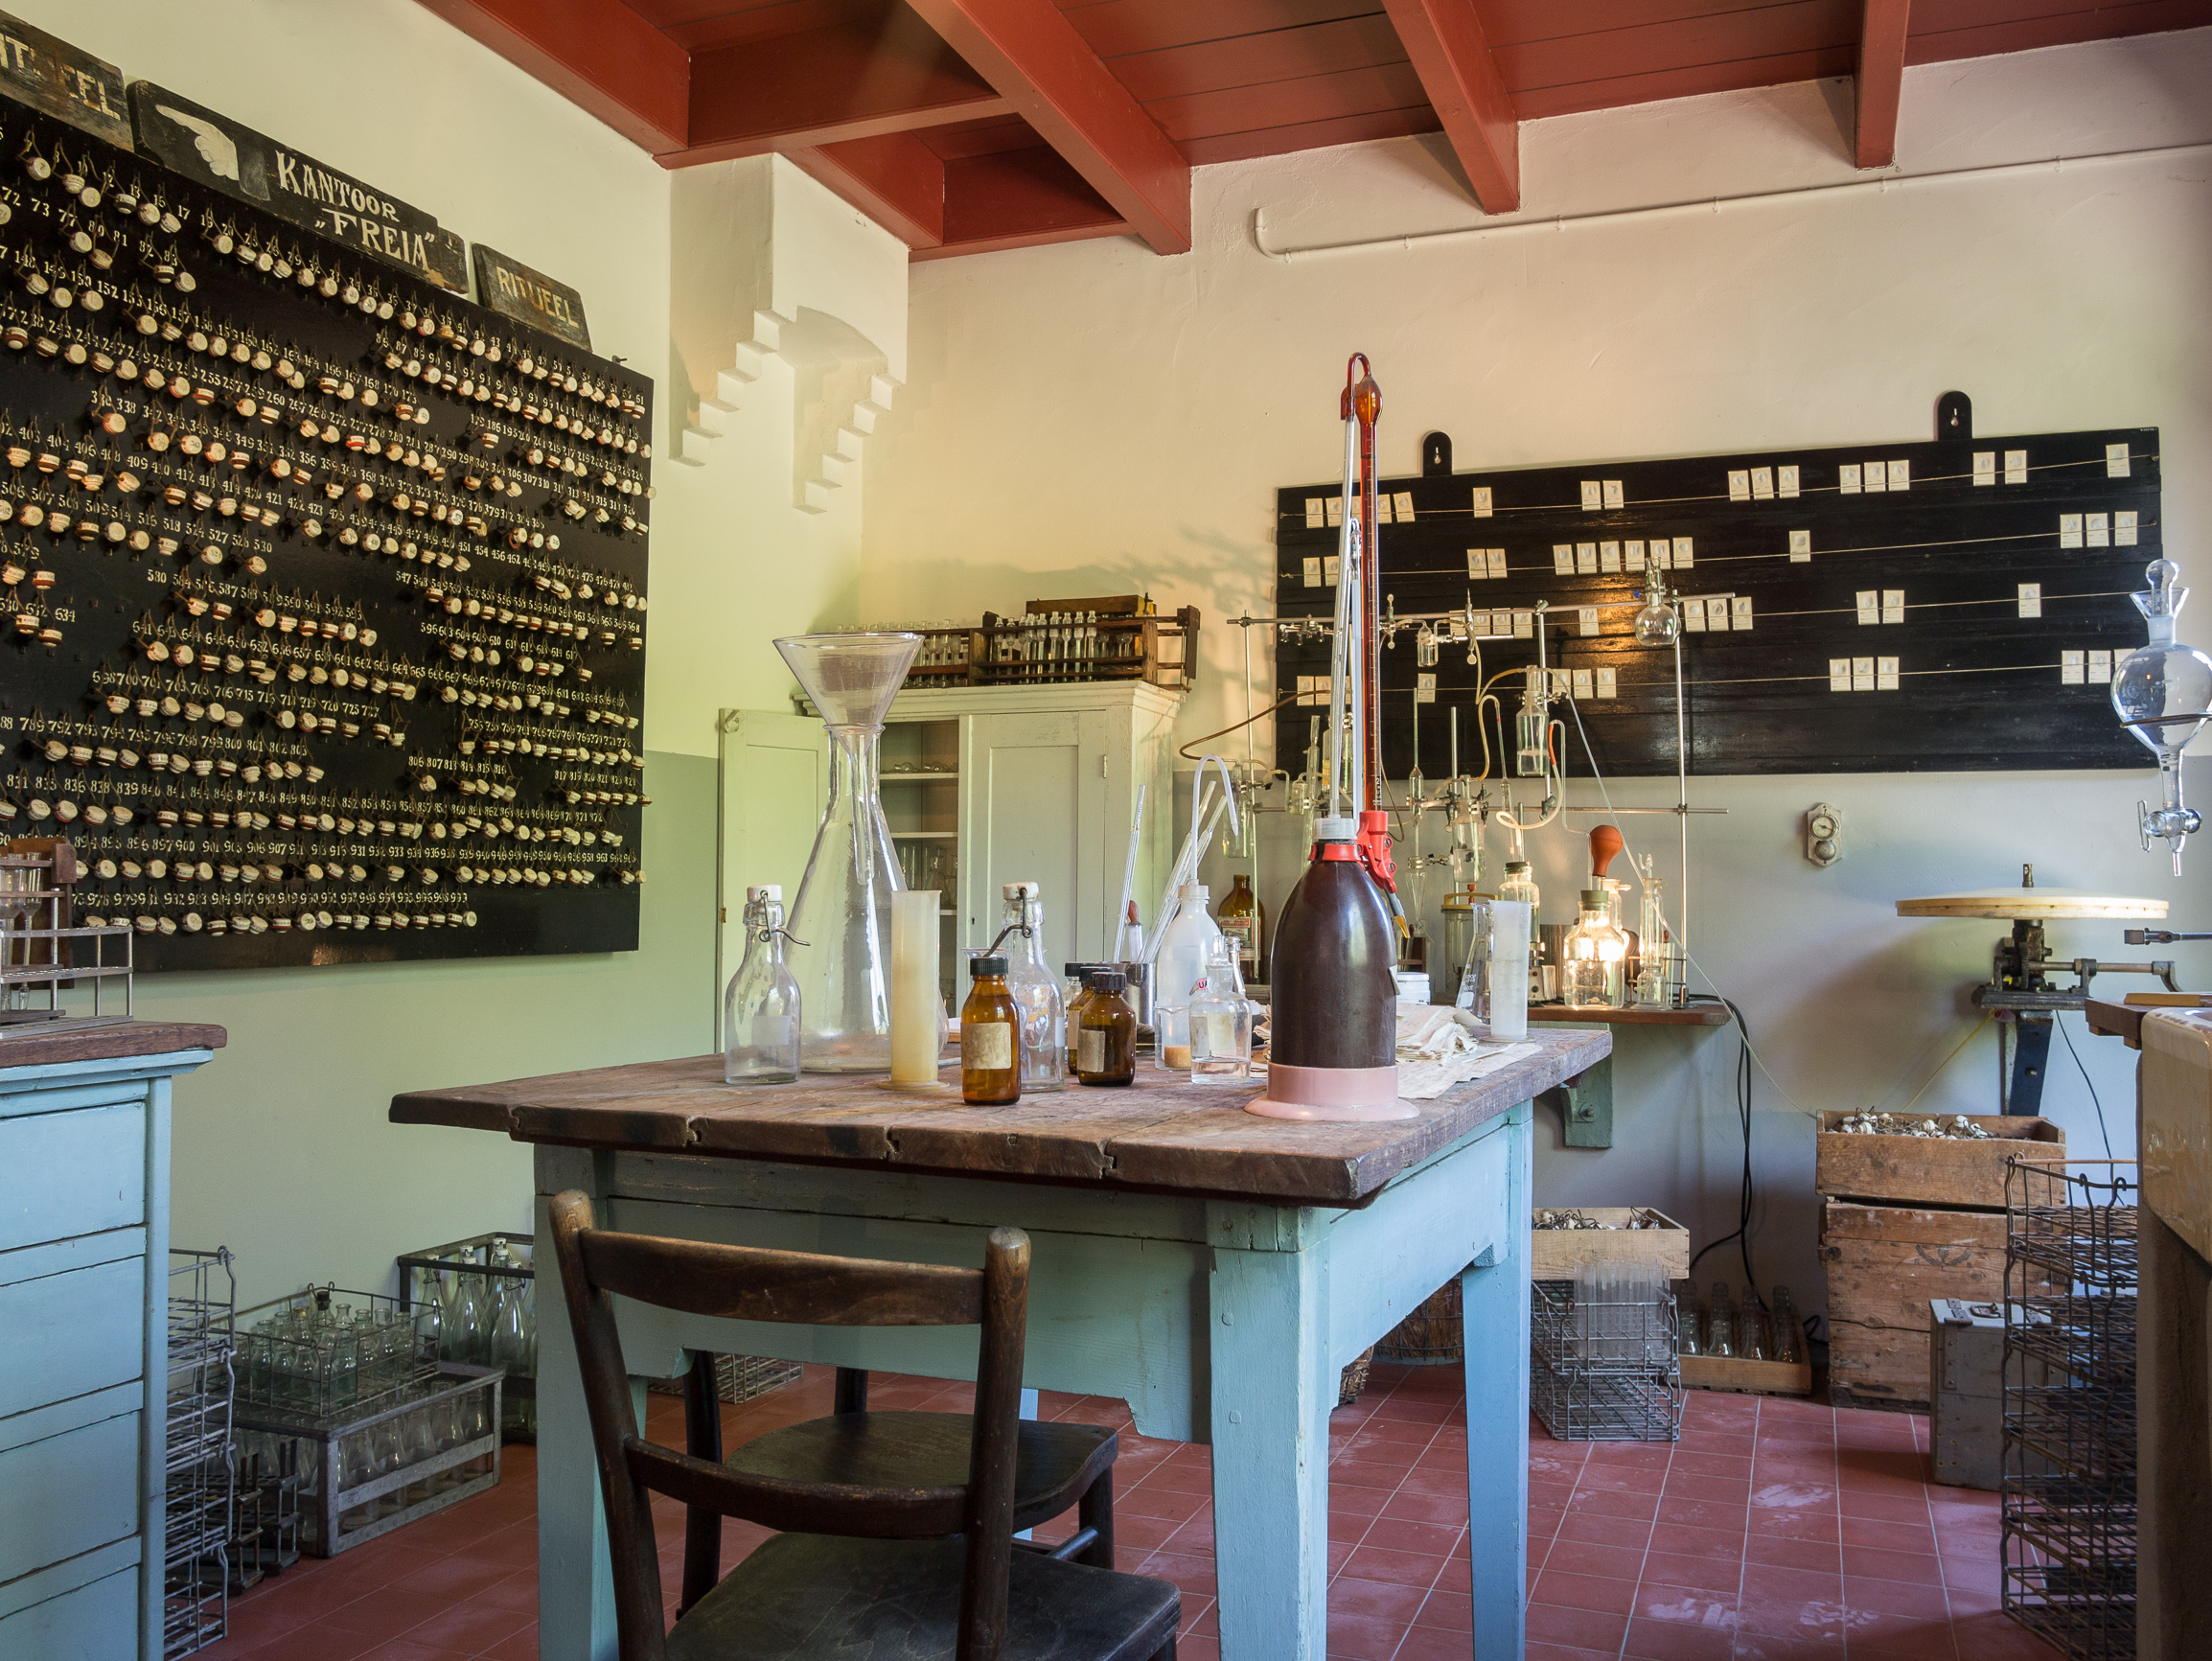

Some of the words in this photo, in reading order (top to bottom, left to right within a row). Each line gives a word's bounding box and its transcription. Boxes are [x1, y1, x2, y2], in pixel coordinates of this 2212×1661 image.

[178, 205, 192, 220] 17
[275, 150, 401, 222] KANTOOR
[2, 186, 22, 207] 72
[32, 198, 50, 218] 73
[88, 220, 105, 237] 80
[114, 231, 127, 247] 81
[140, 241, 154, 258] 82
[396, 341, 407, 355] 87
[496, 265, 579, 329] RITUEEL
[98, 281, 119, 300] 152
[364, 377, 380, 391] 168
[488, 420, 501, 432] 186
[117, 399, 137, 415] 338
[235, 434, 255, 450] 349
[299, 452, 317, 467] 356
[360, 470, 378, 483] 368
[200, 370, 221, 386] 255
[266, 392, 286, 406] 260
[369, 425, 386, 439] 278
[508, 468, 522, 481] 306
[523, 473, 538, 486] 307
[127, 456, 149, 471] 409
[458, 542, 472, 553] 451
[474, 545, 490, 558] 454
[492, 549, 507, 562] 456
[507, 553, 521, 565] 462
[164, 519, 182, 533] 518
[209, 529, 229, 544] 527
[254, 540, 273, 553] 530
[396, 571, 412, 585] 547
[56, 608, 77, 623] 634
[148, 569, 168, 584] 580
[219, 584, 240, 598] 587
[421, 622, 438, 634] 596
[489, 635, 502, 647] 610
[237, 688, 255, 703] 715
[20, 718, 45, 732] 789
[225, 738, 242, 750] 800
[427, 758, 444, 771] 807
[117, 783, 139, 796] 839
[175, 840, 196, 853] 900
[268, 842, 288, 856] 907
[351, 845, 367, 857] 931
[389, 846, 404, 858] 933
